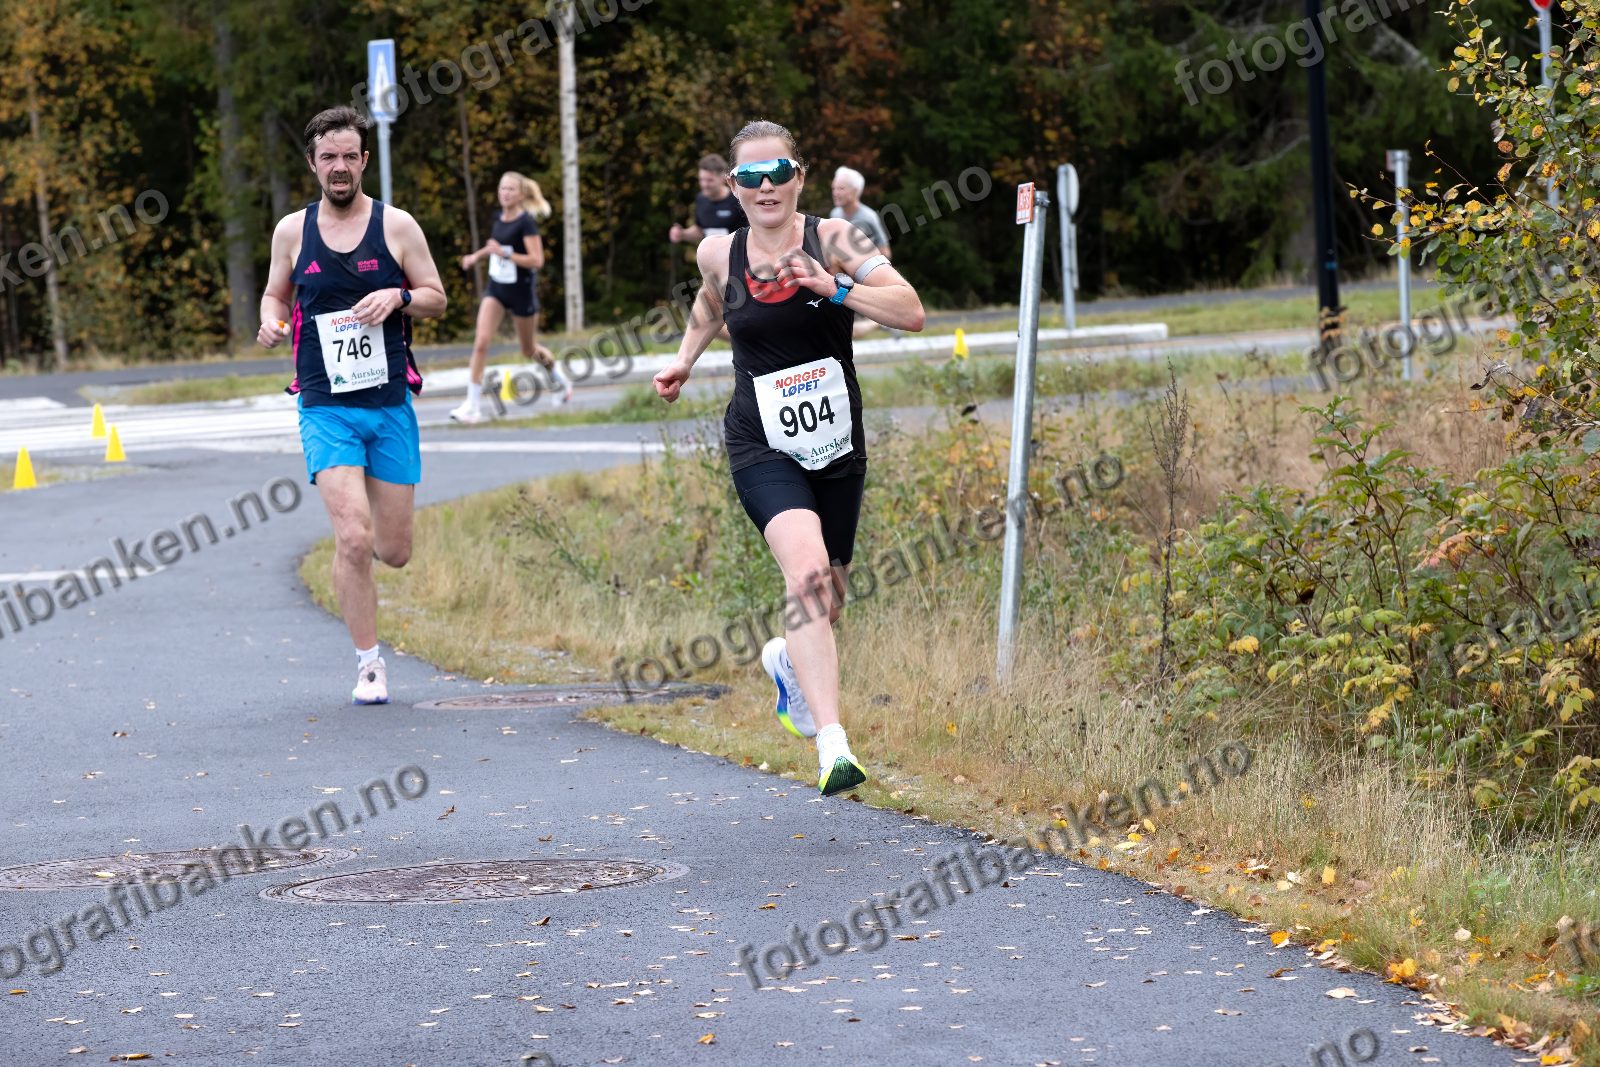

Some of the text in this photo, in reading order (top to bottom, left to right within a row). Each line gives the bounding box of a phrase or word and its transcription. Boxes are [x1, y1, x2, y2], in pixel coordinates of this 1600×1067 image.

[331, 316, 359, 327] NORG
[332, 334, 372, 363] 746
[351, 367, 386, 380] Aurskog
[775, 367, 827, 389] NORGES
[782, 378, 820, 398] LØPET
[779, 395, 836, 438] 904
